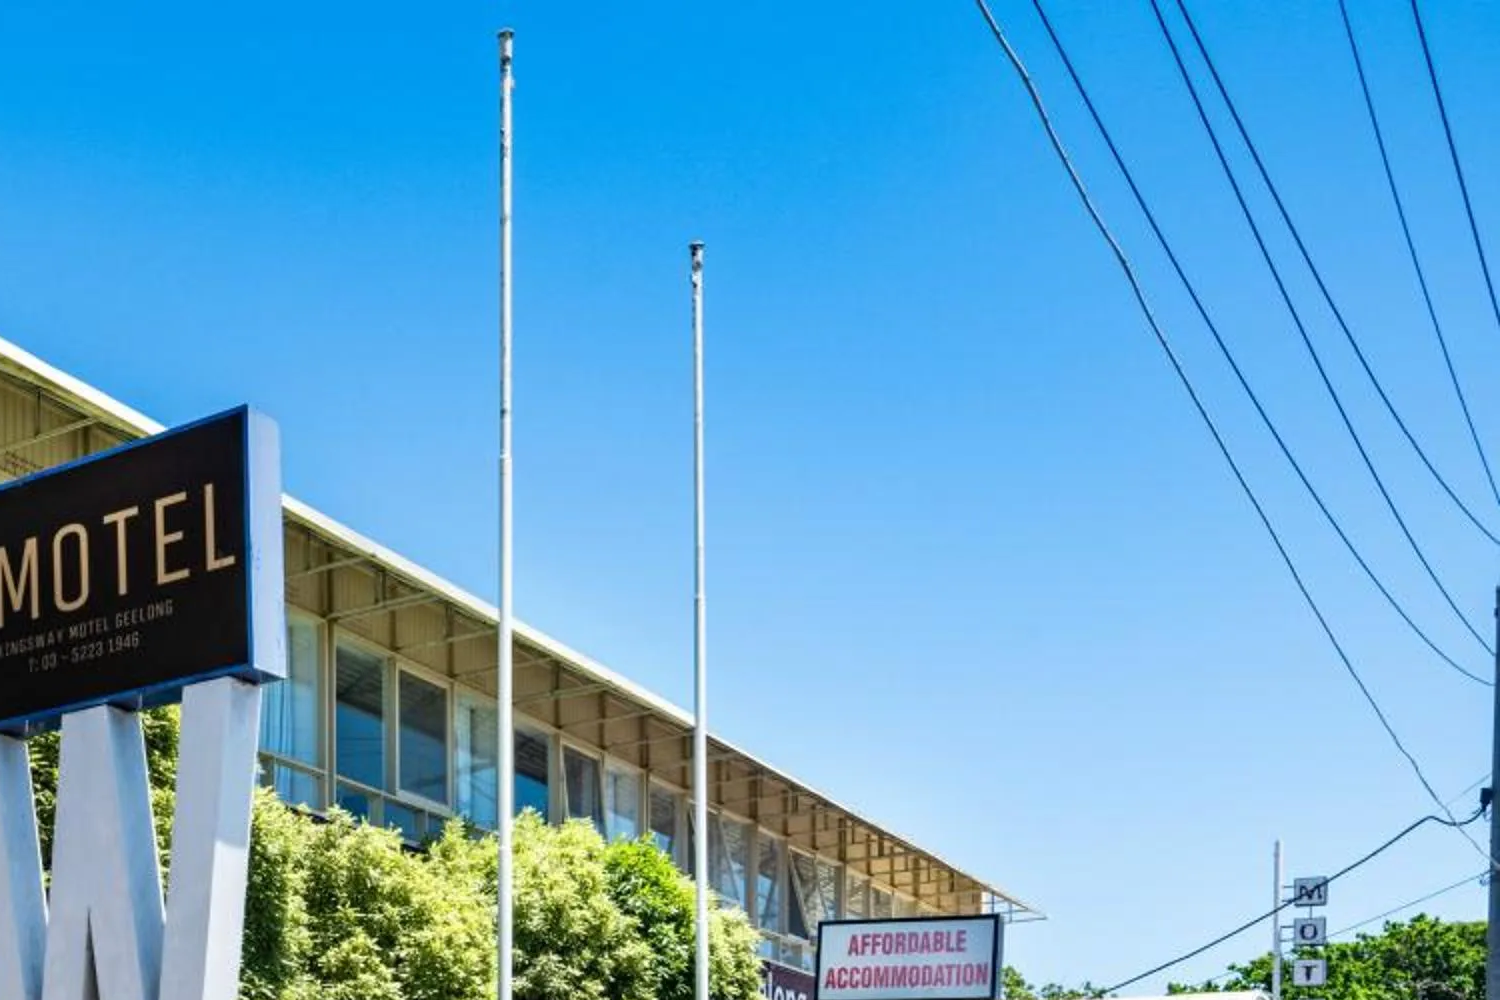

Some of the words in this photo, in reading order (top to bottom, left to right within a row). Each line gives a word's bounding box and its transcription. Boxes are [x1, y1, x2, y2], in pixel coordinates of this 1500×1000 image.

[68, 617, 109, 639] MOTEL
[115, 599, 174, 629] GEELONG
[848, 929, 967, 956] AFFORDABLE
[824, 962, 989, 990] ACCOMMODATION
